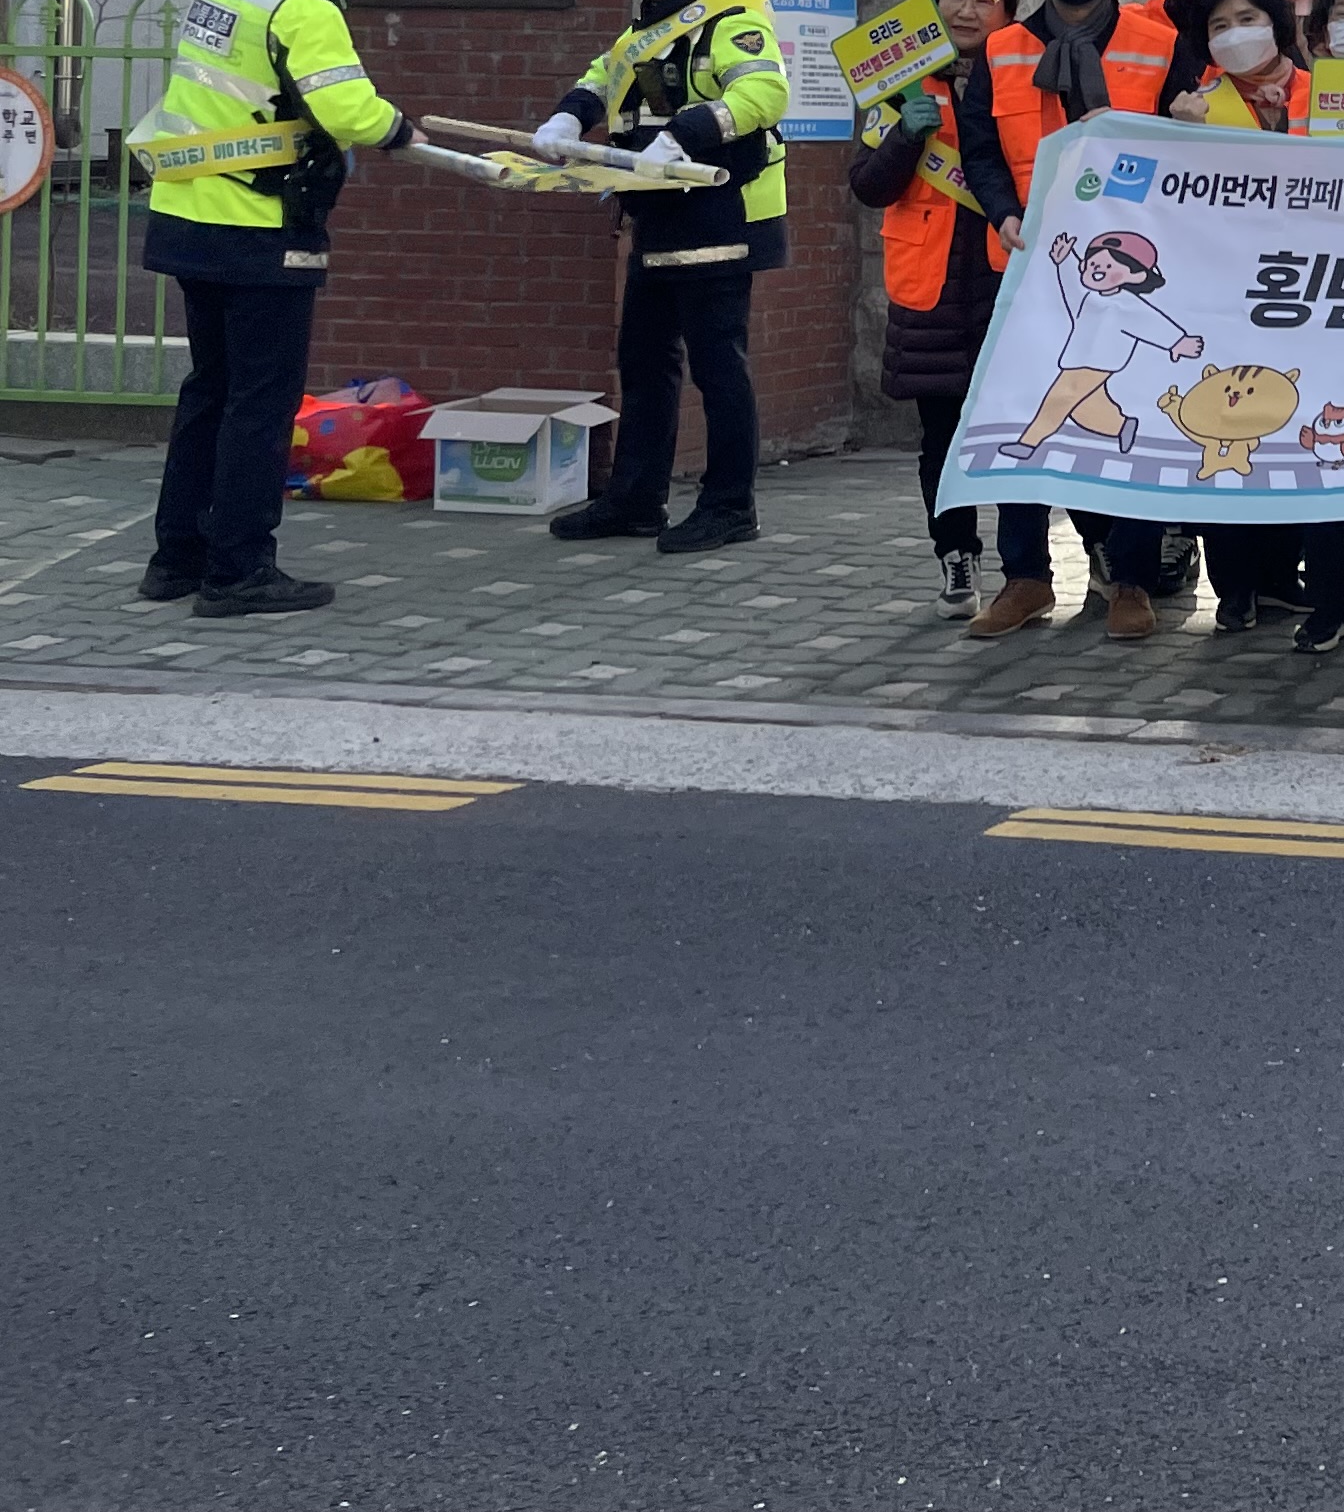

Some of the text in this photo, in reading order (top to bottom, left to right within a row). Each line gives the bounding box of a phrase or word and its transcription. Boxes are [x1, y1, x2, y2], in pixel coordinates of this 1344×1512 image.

[869, 19, 904, 45] 우리는
[850, 42, 904, 84] 안전벨트를
[1160, 171, 1279, 208] 아이먼저
